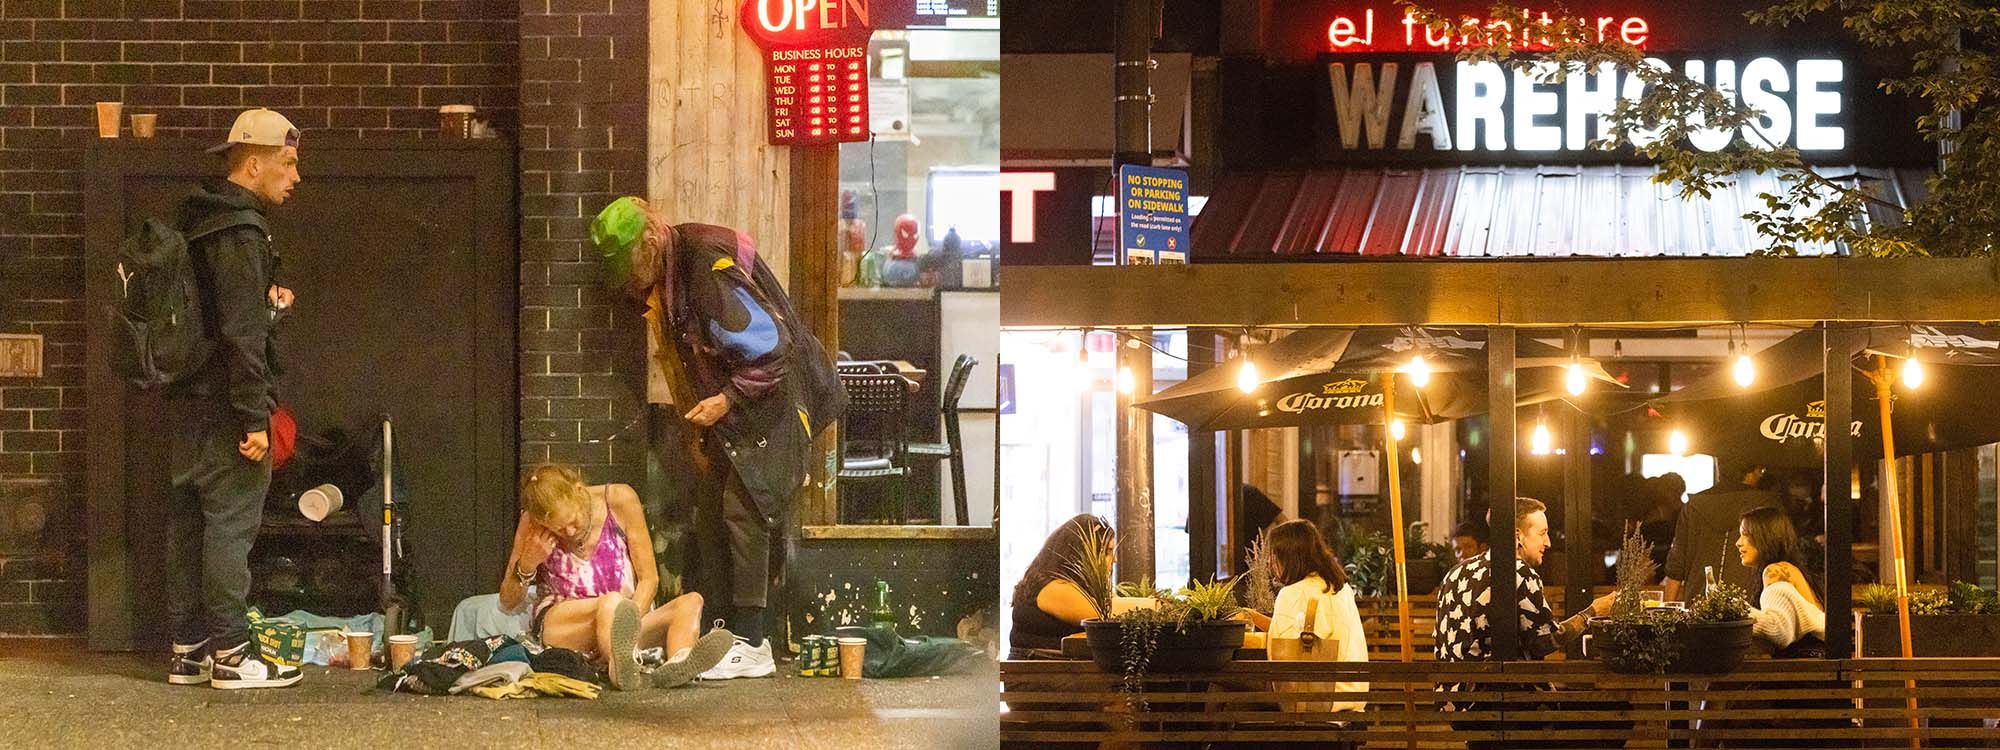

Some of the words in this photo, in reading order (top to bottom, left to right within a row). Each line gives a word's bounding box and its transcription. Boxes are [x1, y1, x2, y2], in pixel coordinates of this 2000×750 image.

[757, 0, 870, 33] OPEN
[1328, 8, 1374, 47] el
[773, 49, 821, 61] BUSINESS
[825, 47, 864, 59] HOURS
[774, 65, 796, 74] MON
[774, 76, 791, 85] TUE
[774, 86, 796, 95] WED
[775, 97, 794, 106] THU
[775, 108, 789, 117] FRI
[775, 118, 791, 128] SAT
[775, 129, 795, 138] SUN
[1127, 175, 1141, 185] NO
[1143, 176, 1183, 189] STOPPING
[1131, 187, 1143, 197] OR
[1144, 188, 1181, 201] PARKING
[1128, 199, 1141, 209] ON
[1143, 200, 1184, 213] SIDEWALK
[1276, 391, 1384, 414] Corona
[1760, 413, 1863, 444] Cora
